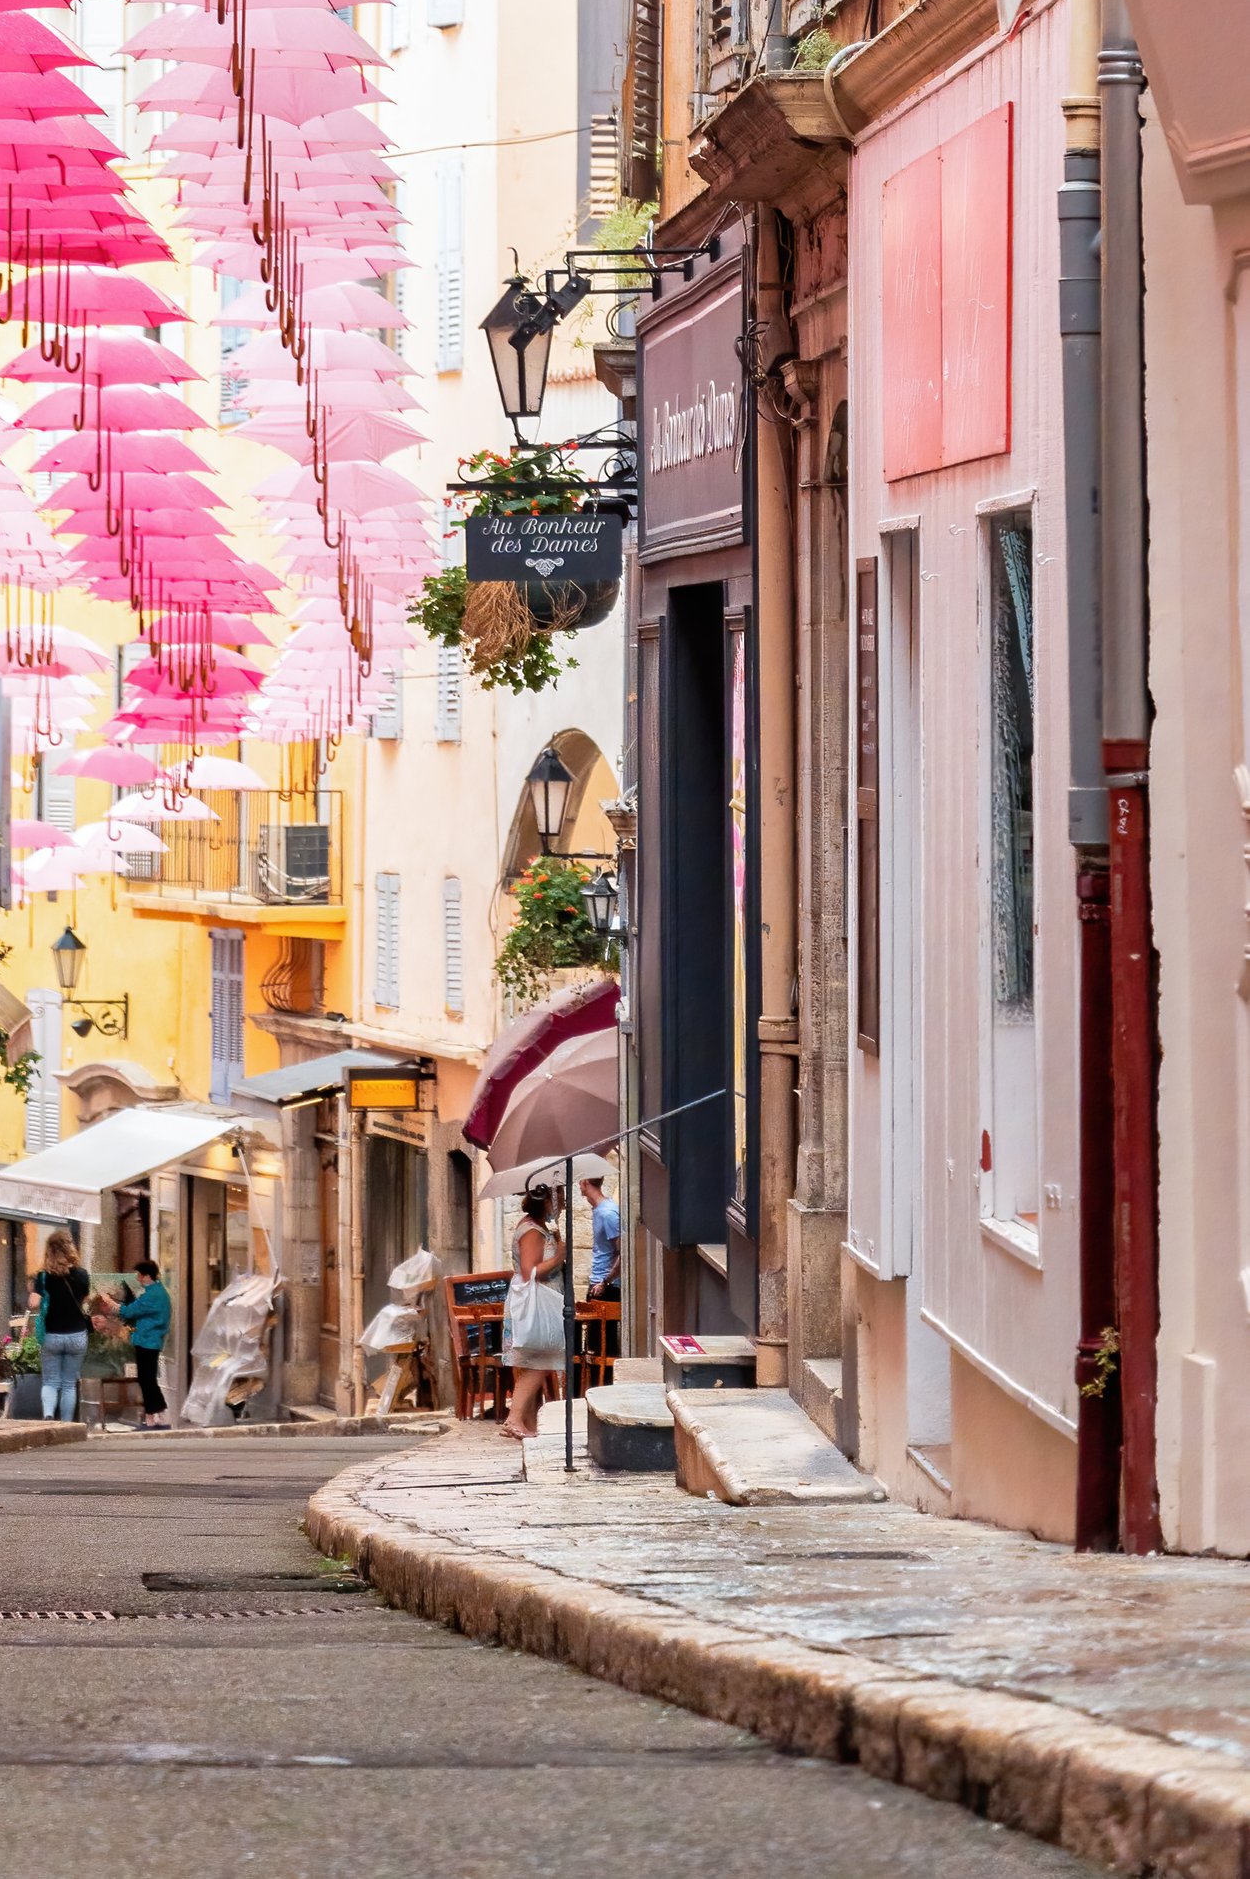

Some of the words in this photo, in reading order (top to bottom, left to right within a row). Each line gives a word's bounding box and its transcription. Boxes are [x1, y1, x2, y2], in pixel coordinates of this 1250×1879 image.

[483, 518, 515, 535] Au
[520, 517, 605, 535] Bonheur
[491, 536, 521, 553] des
[530, 536, 598, 553] Dames
